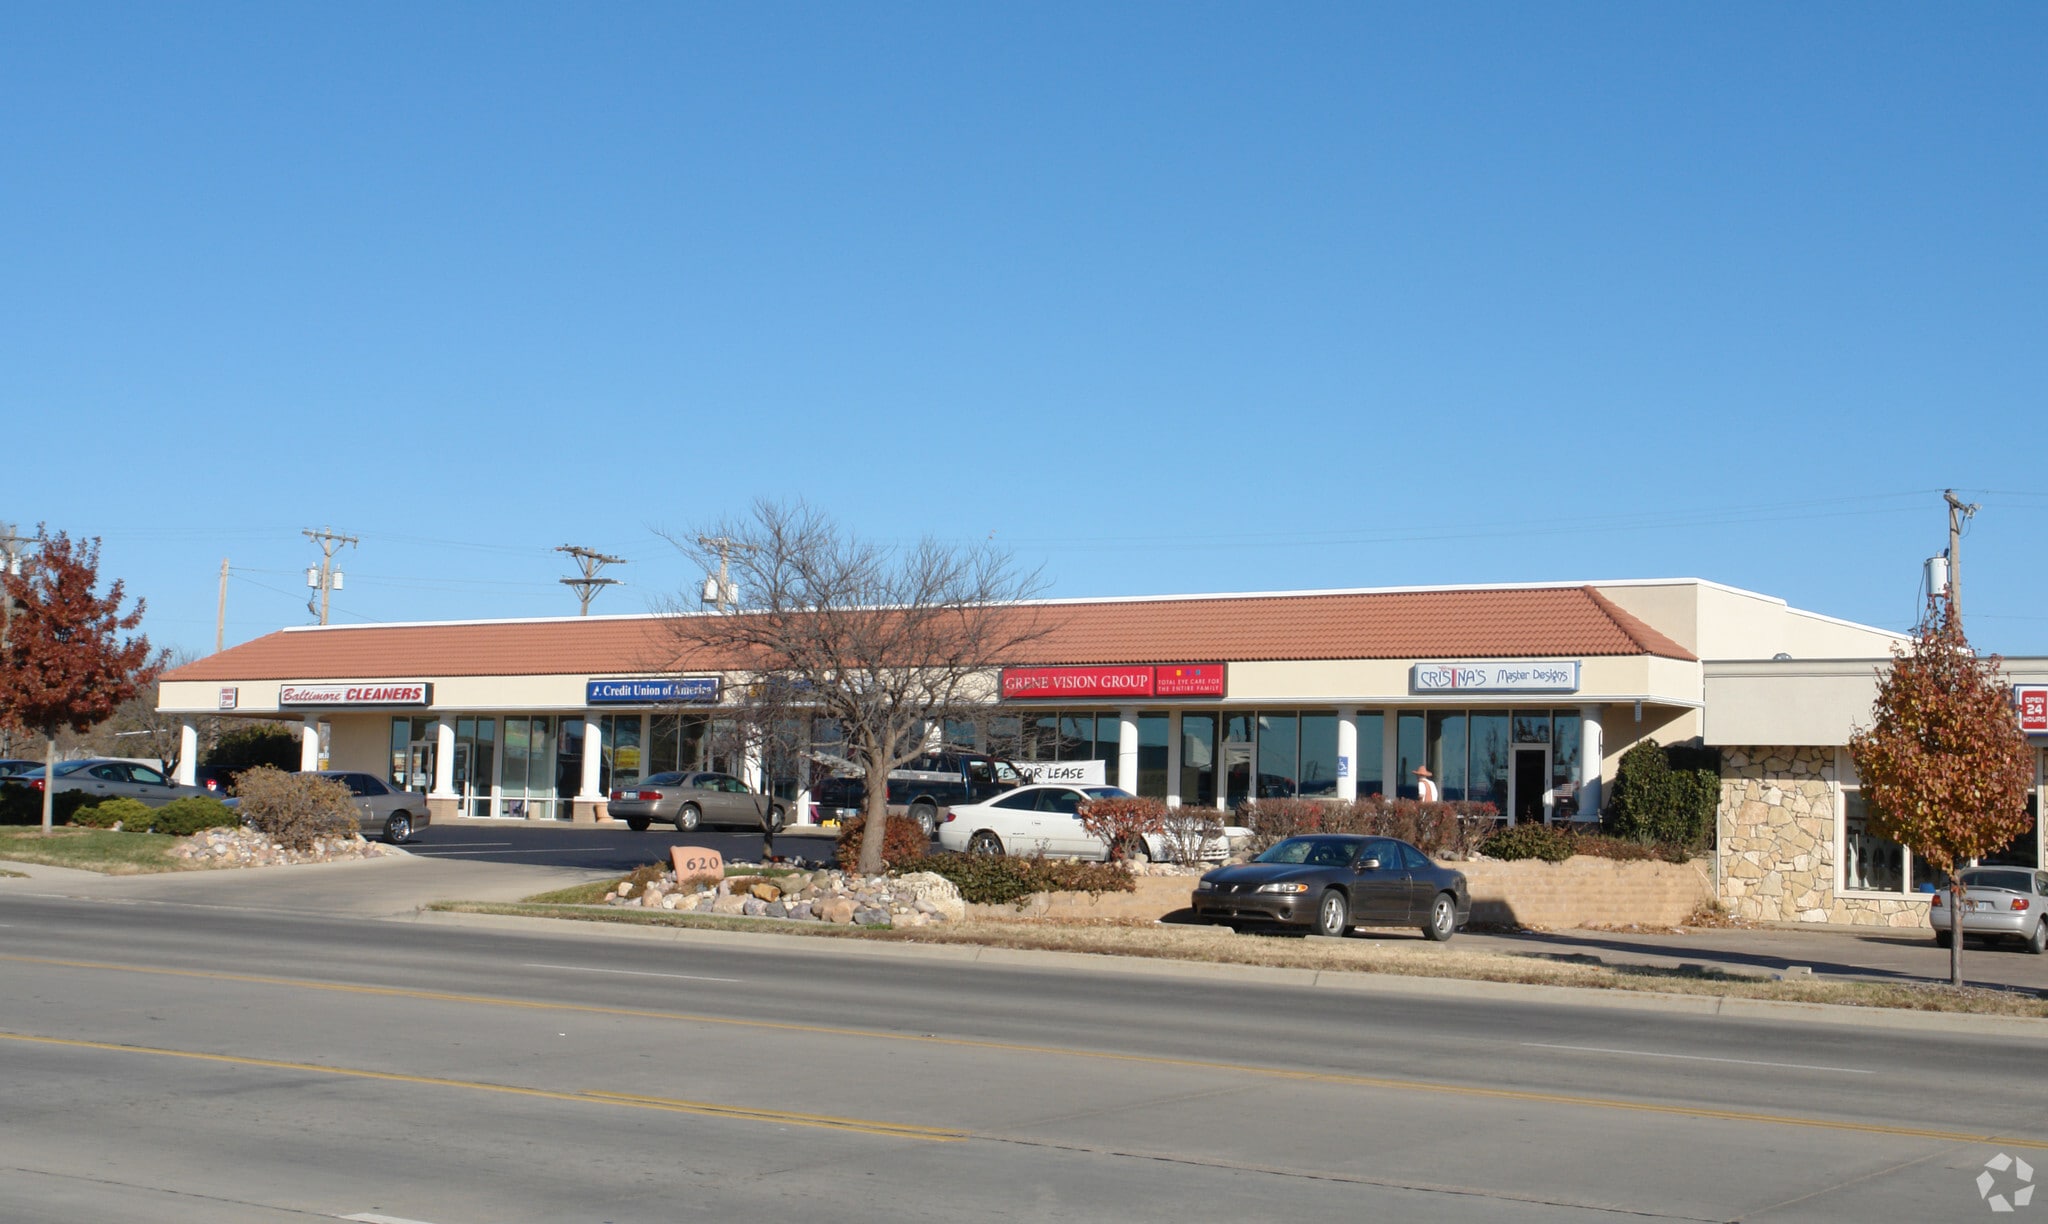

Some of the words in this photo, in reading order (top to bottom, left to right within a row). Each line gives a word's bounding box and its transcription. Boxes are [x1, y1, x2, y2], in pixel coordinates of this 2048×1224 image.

[1005, 676, 1049, 689] GRENE
[1053, 675, 1097, 689] VISION
[1101, 674, 1148, 688] GROUP
[1497, 669, 1530, 684] Master
[1533, 668, 1568, 684] Designs
[283, 688, 341, 701] Baltimore
[345, 687, 422, 701] CLEANERS
[603, 685, 632, 697] Credit
[634, 684, 660, 697] Union
[662, 684, 673, 696] of
[674, 683, 712, 696] America
[2026, 704, 2043, 715] 24
[1048, 767, 1085, 779] LEASE
[686, 856, 719, 871] 620
